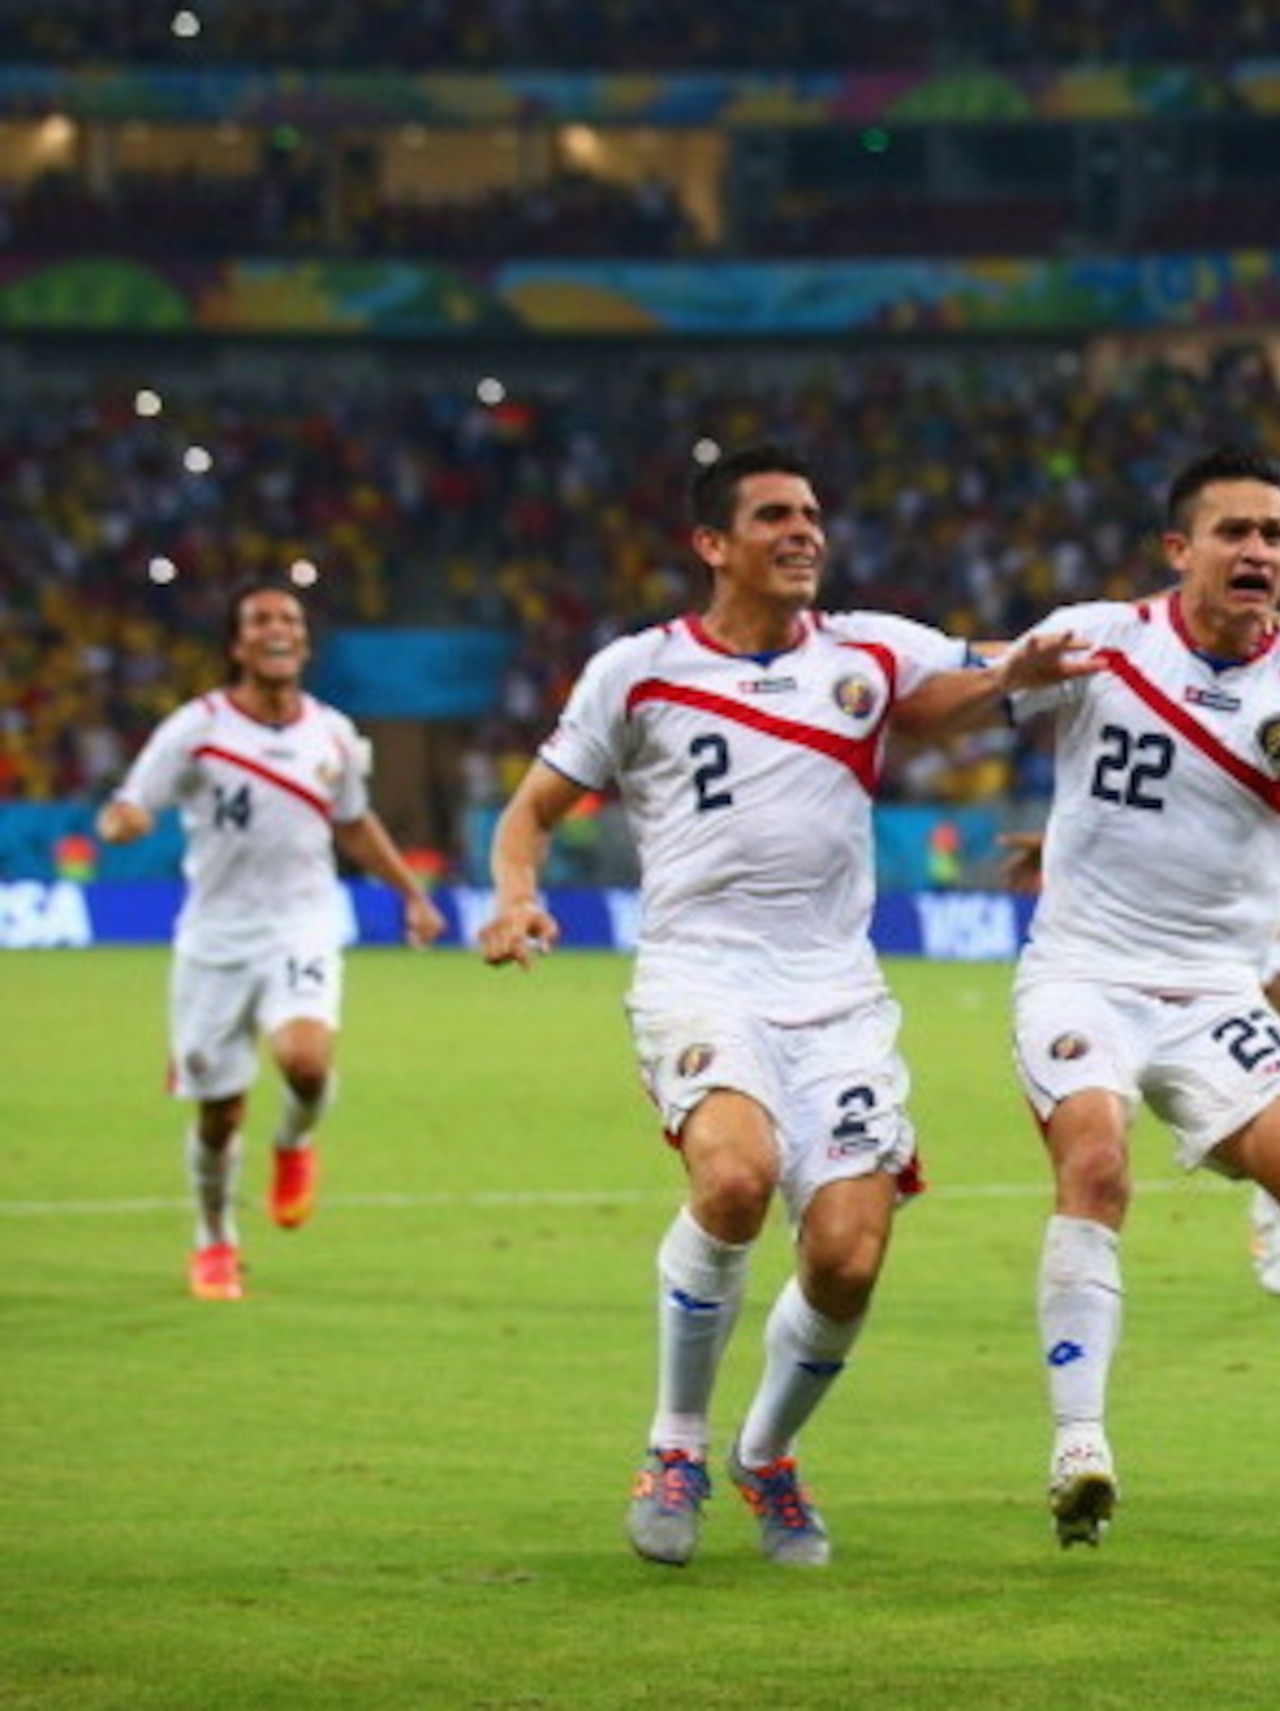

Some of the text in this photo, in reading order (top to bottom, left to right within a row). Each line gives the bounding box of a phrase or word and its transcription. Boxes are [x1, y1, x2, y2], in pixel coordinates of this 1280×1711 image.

[688, 732, 733, 813] 2
[1090, 724, 1176, 812] 22
[213, 783, 252, 831] 14
[831, 1086, 876, 1138] 2
